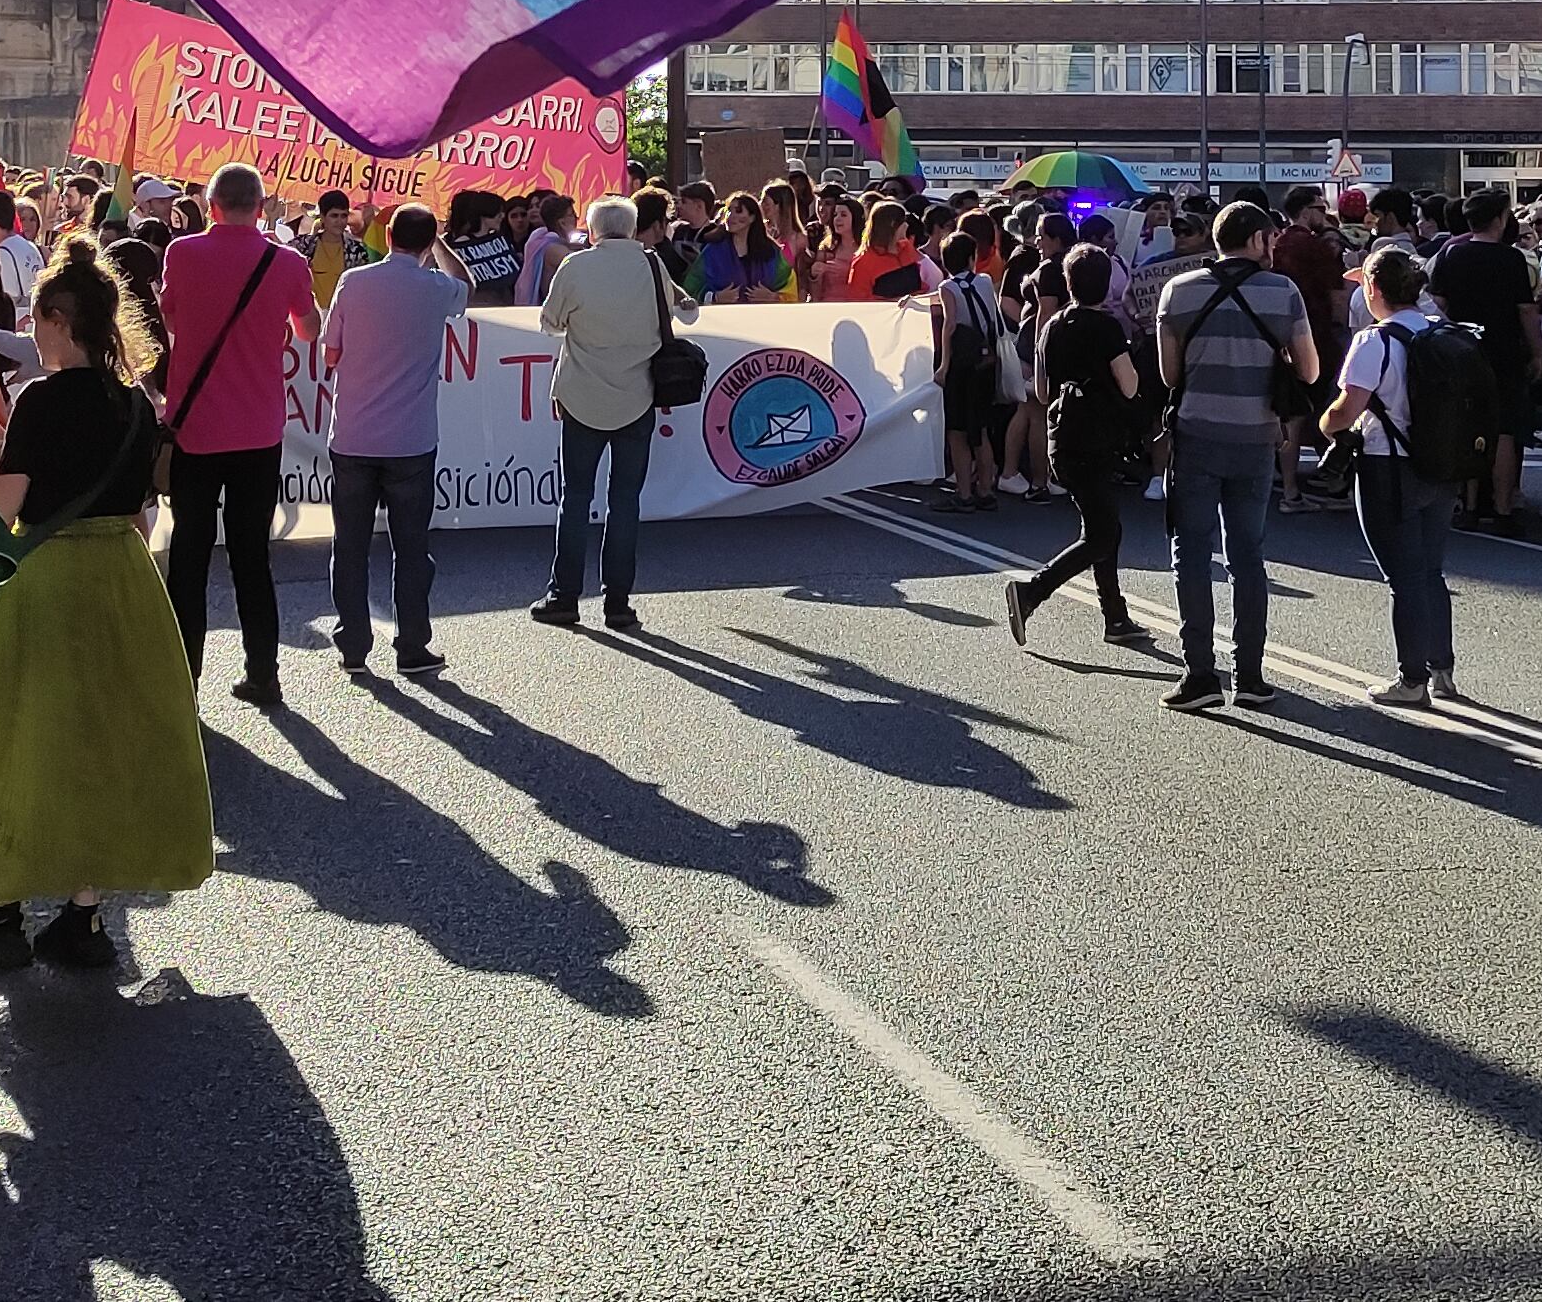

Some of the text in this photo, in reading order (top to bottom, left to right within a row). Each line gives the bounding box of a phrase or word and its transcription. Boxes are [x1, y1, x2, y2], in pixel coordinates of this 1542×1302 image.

[255, 149, 427, 198] LA LUCHA SIGUE
[933, 165, 975, 175] MUTUAL
[1160, 168, 1223, 177] MC MUTAL
[1281, 168, 1299, 177] MC
[719, 358, 763, 401] HARRO
[806, 363, 846, 404] PRIDE
[805, 434, 848, 472] SALGAI
